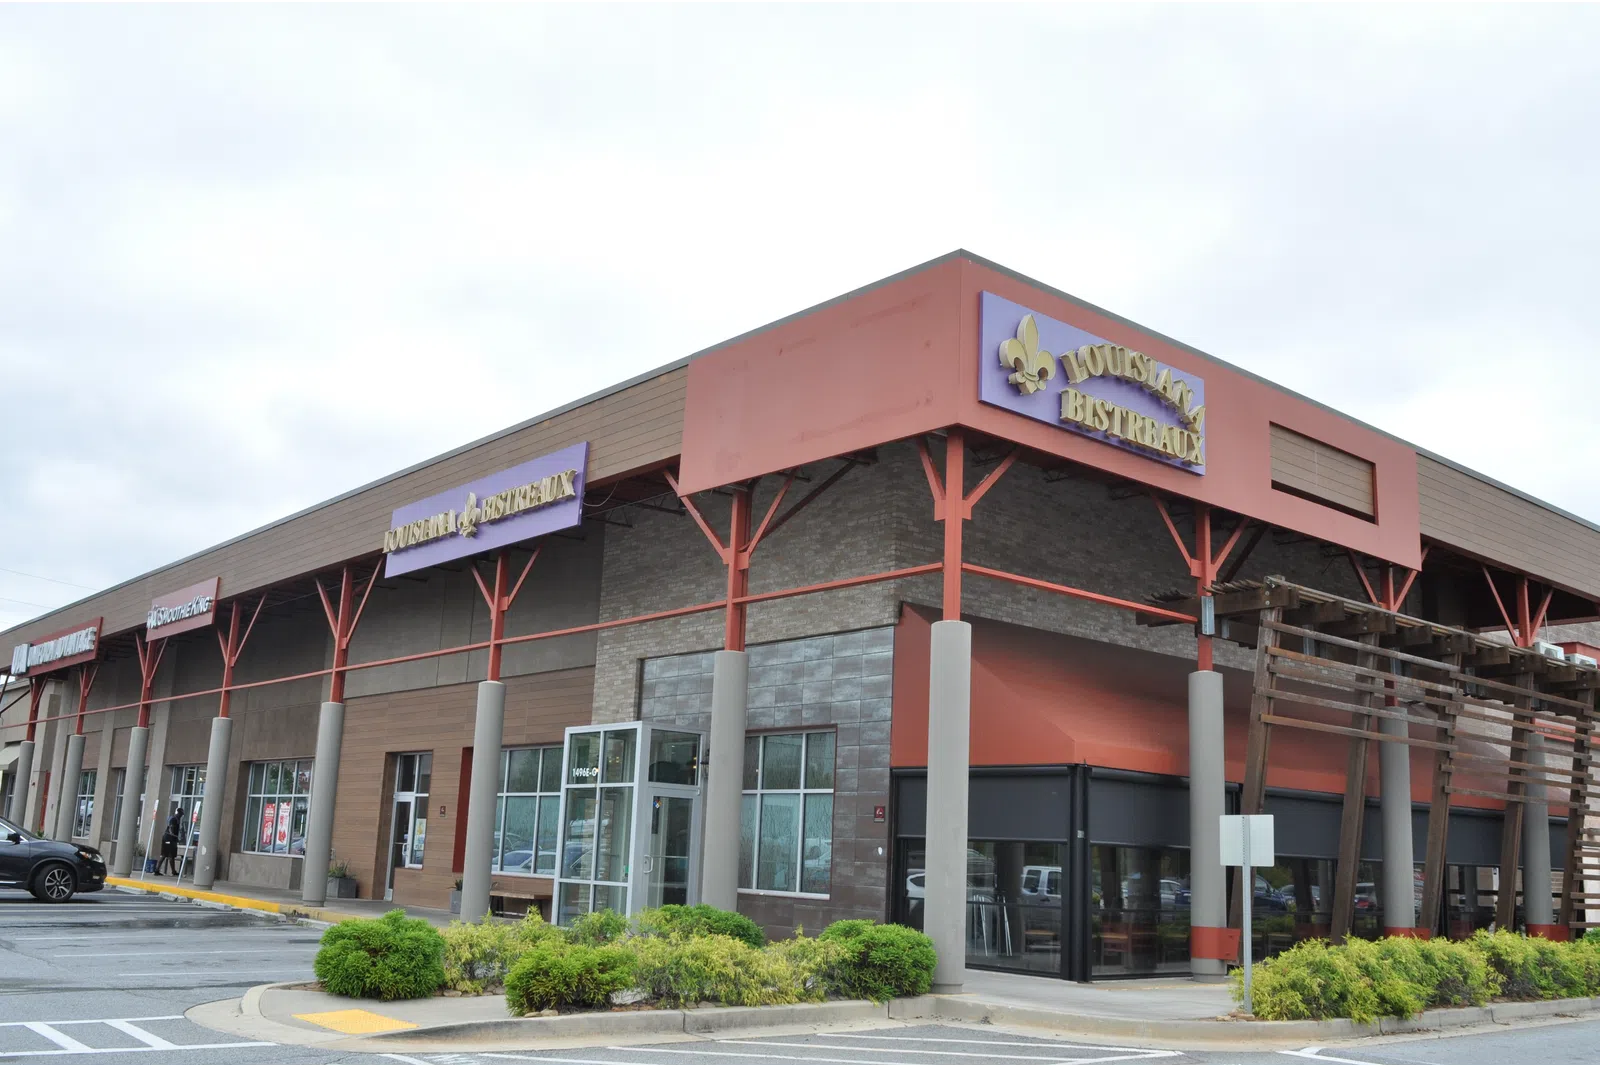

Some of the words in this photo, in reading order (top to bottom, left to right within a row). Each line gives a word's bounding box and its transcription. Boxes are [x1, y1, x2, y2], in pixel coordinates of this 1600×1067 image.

[1060, 343, 1206, 433] LOUISIANA
[1060, 387, 1205, 466] BISTREAUX
[382, 509, 458, 554] LOUISIANA
[479, 468, 578, 523] BISTREAUX
